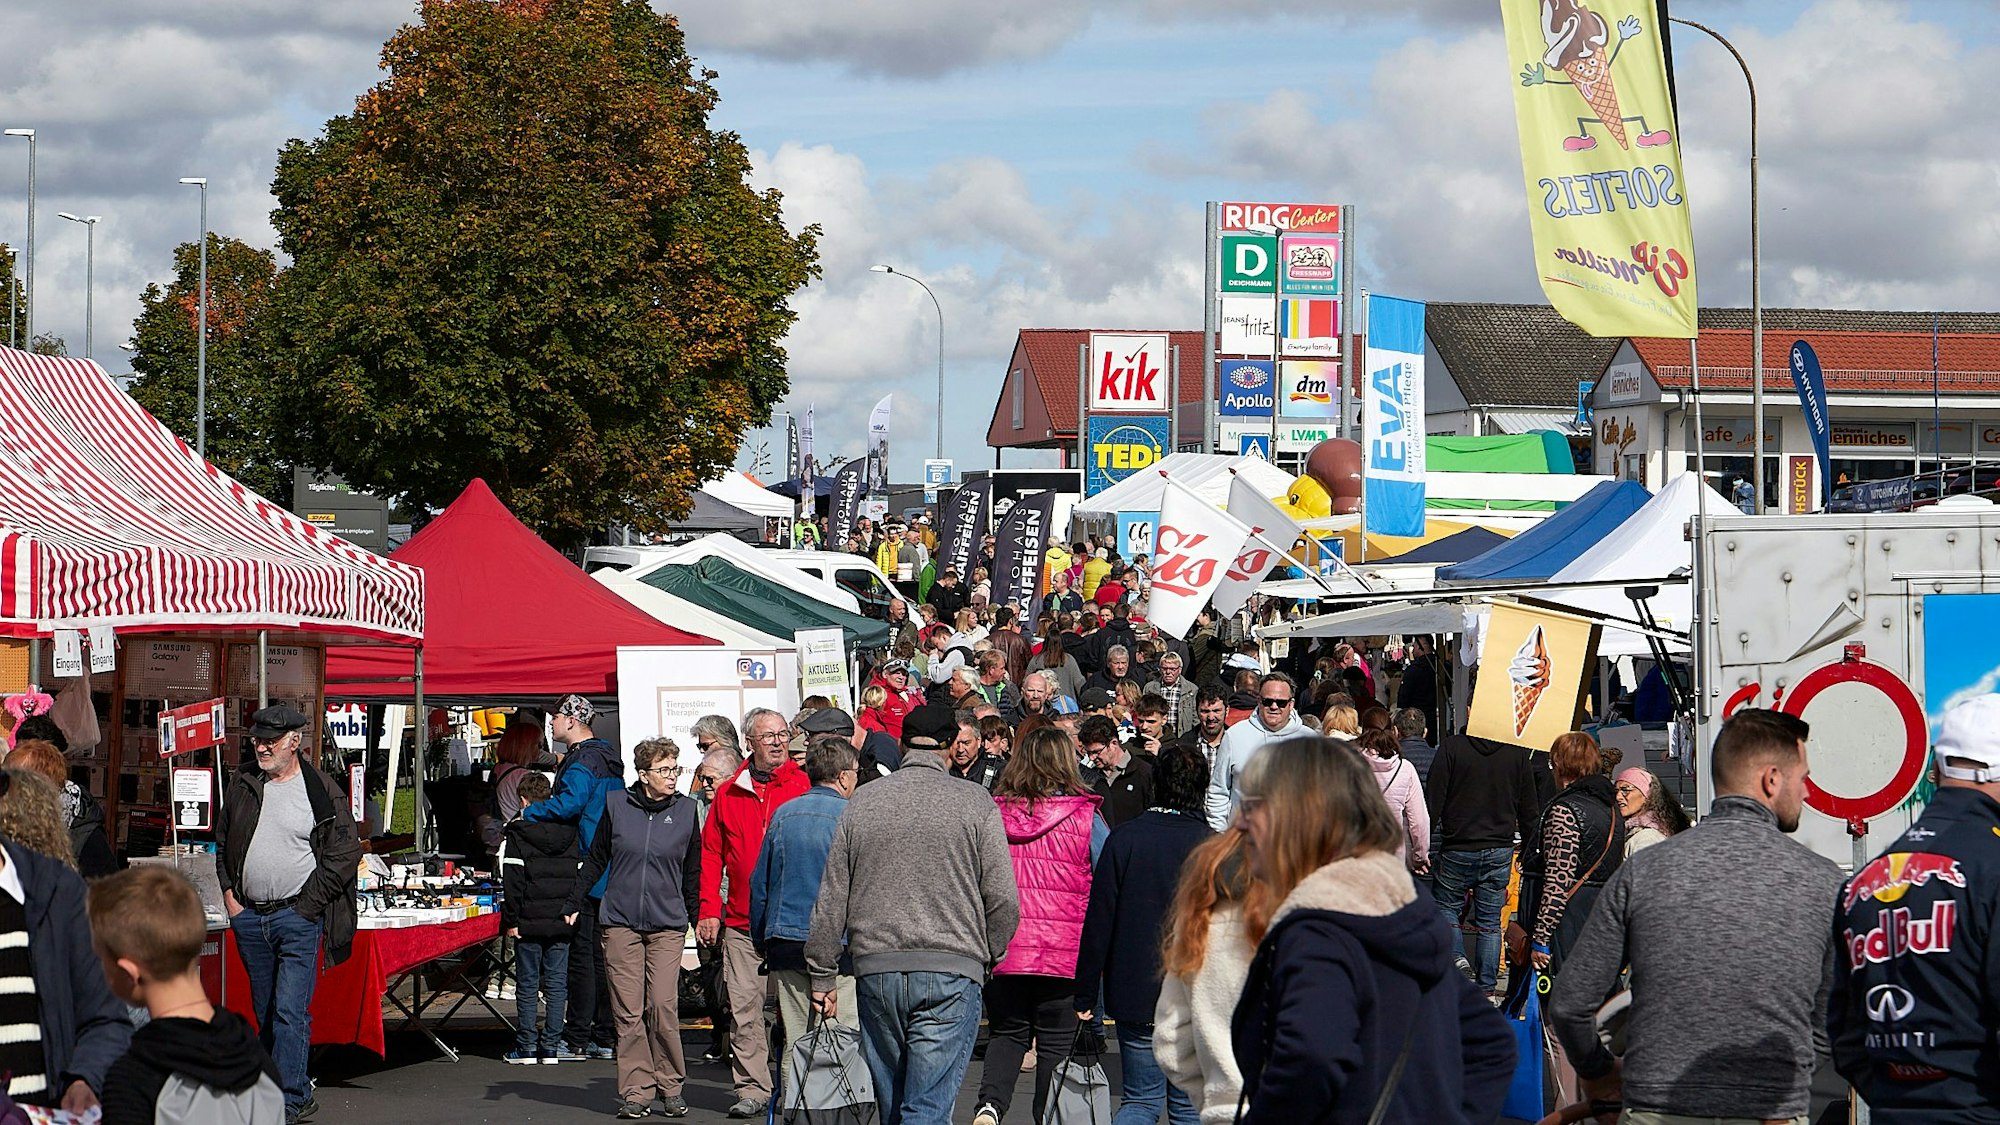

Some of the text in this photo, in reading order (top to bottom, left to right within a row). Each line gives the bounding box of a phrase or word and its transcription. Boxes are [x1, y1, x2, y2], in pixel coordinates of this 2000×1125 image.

[1226, 205, 1336, 229] RING Center
[1236, 243, 1268, 277] D
[1224, 314, 1275, 337] JEANS fritz
[1296, 375, 1326, 393] dm
[1403, 363, 1412, 405] Pflege
[1224, 393, 1273, 409] Apollo
[1801, 371, 1825, 435] HYUNDAI
[1371, 362, 1405, 472] EVA
[1404, 410, 1412, 437] und
[1291, 430, 1316, 441] LVM
[1983, 428, 2000, 443] Ca
[1093, 443, 1162, 469] TEDi
[1793, 461, 1806, 512] HSTÜCK
[950, 489, 970, 562] TOHAUS
[1008, 508, 1026, 604] UTOHAUS
[1018, 509, 1042, 622] RAIFFEISEN
[152, 653, 179, 662] Galaxy
[153, 643, 191, 652] SAMSUNG
[268, 648, 298, 656] MSUNG
[56, 658, 80, 671] Eingang
[92, 655, 113, 667] Eingang
[808, 663, 840, 675] AKTUELLES
[666, 700, 716, 709] Tiergestützte
[666, 708, 700, 717] Therapie
[1892, 899, 1957, 957] Bull
